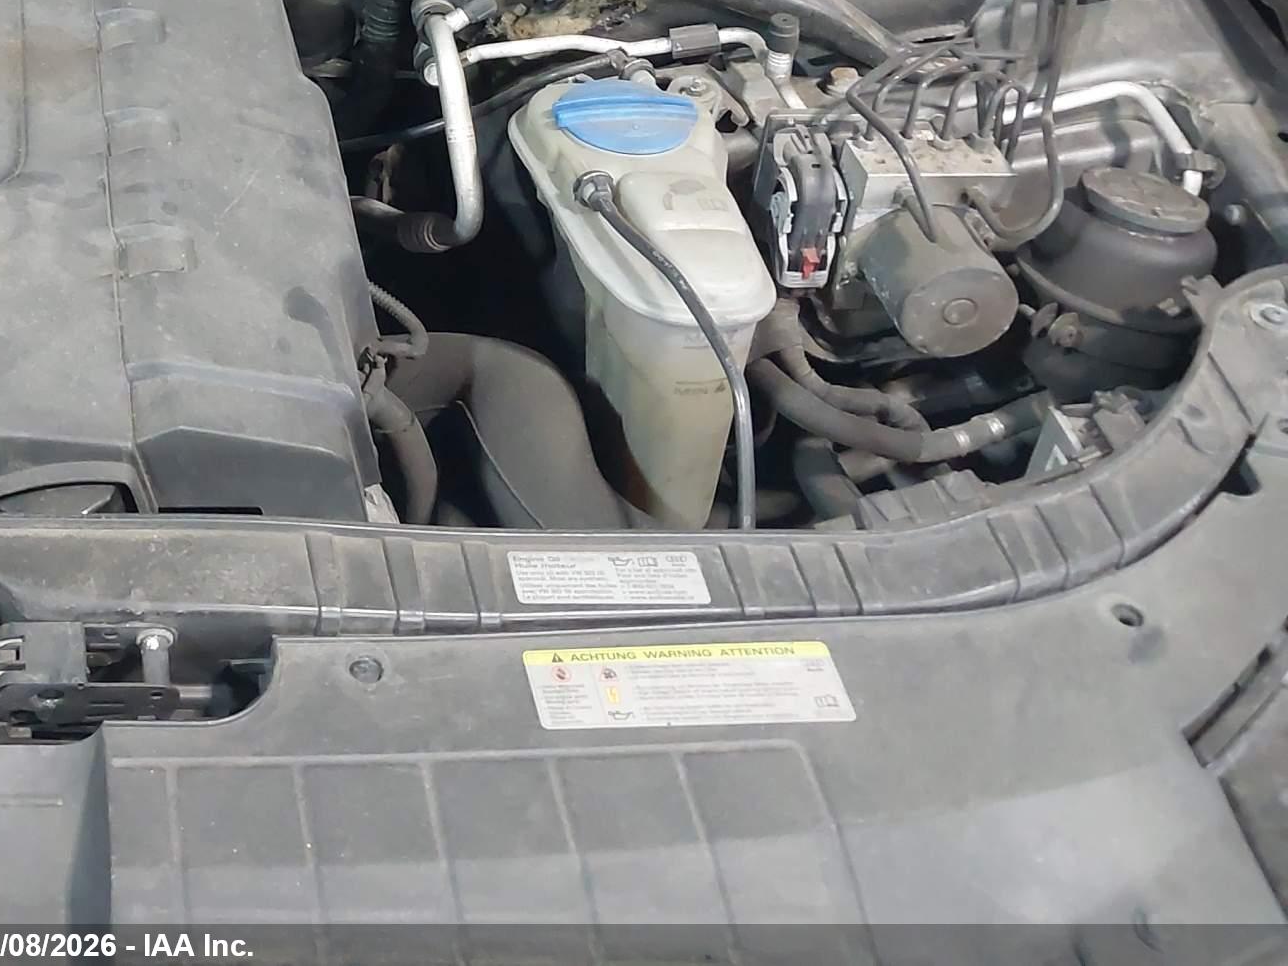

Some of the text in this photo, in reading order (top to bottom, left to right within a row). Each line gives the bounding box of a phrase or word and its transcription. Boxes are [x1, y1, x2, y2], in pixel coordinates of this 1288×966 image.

[570, 646, 795, 662] ACHTUNG WARNING ATTENTION
